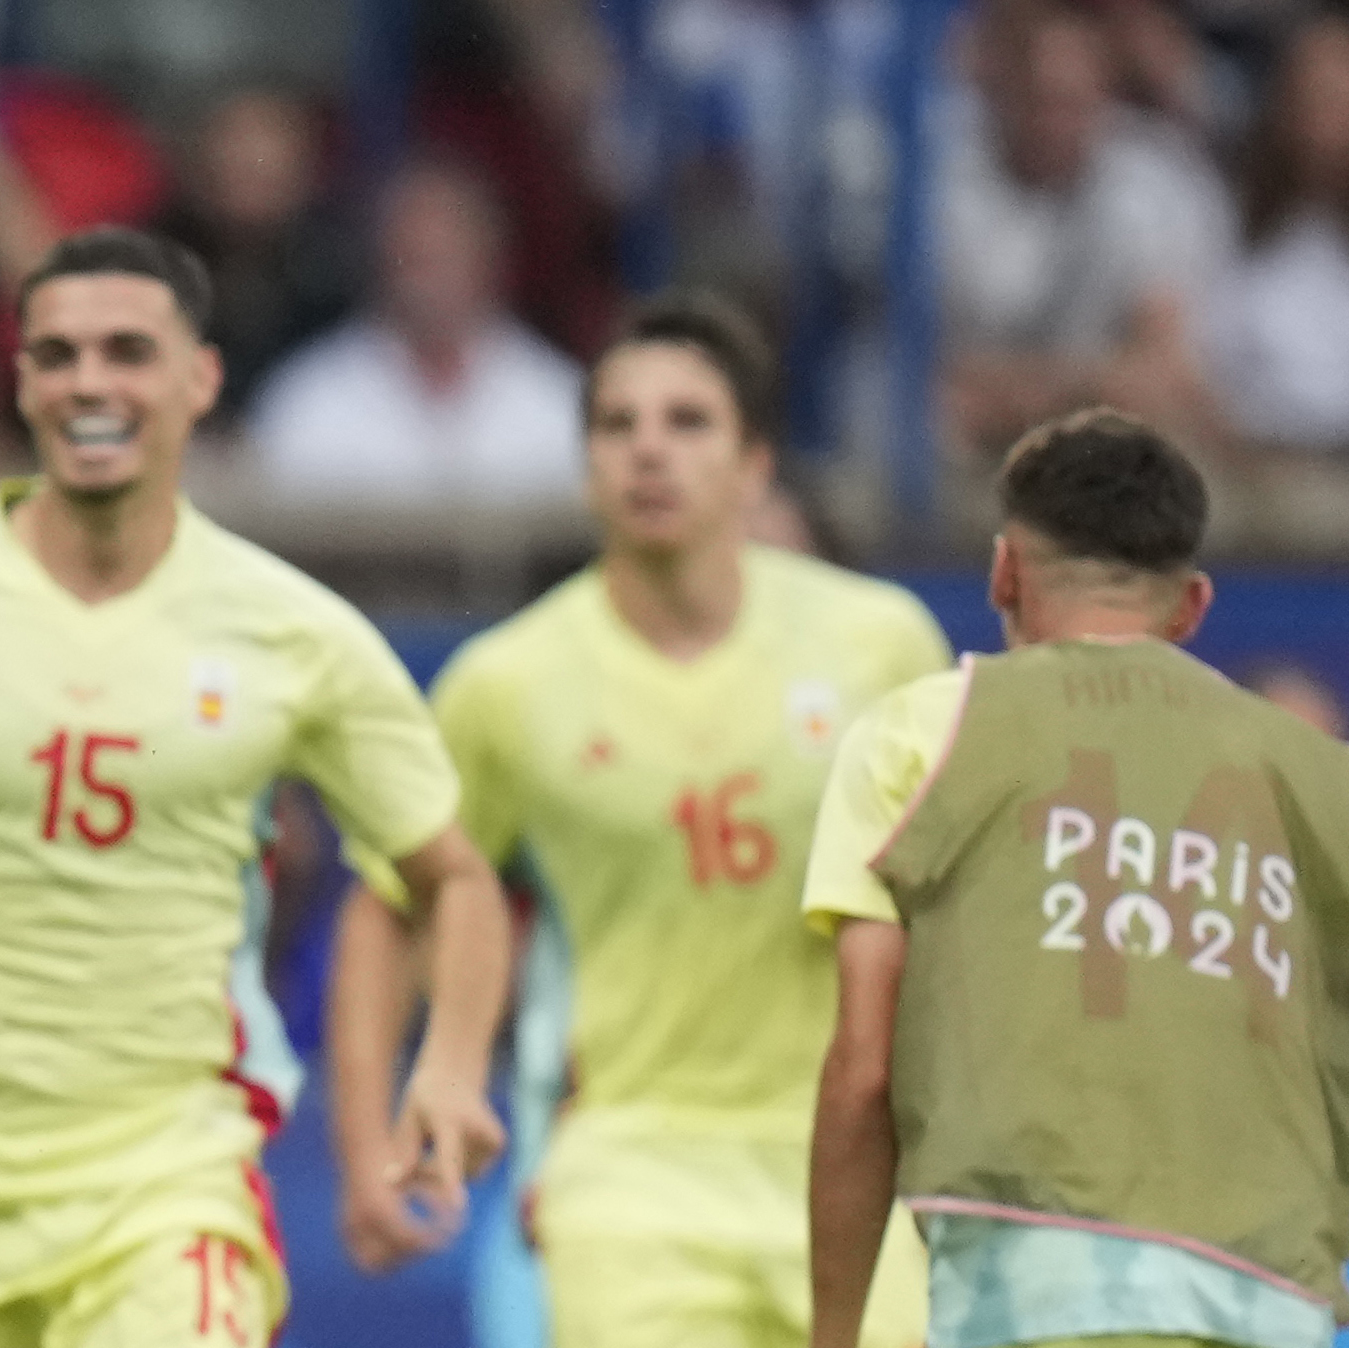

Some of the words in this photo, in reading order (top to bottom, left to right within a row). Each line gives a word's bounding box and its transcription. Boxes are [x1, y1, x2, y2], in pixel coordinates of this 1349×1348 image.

[31, 725, 140, 850] 15
[669, 771, 779, 889] 16
[1040, 881, 1293, 999] 2024
